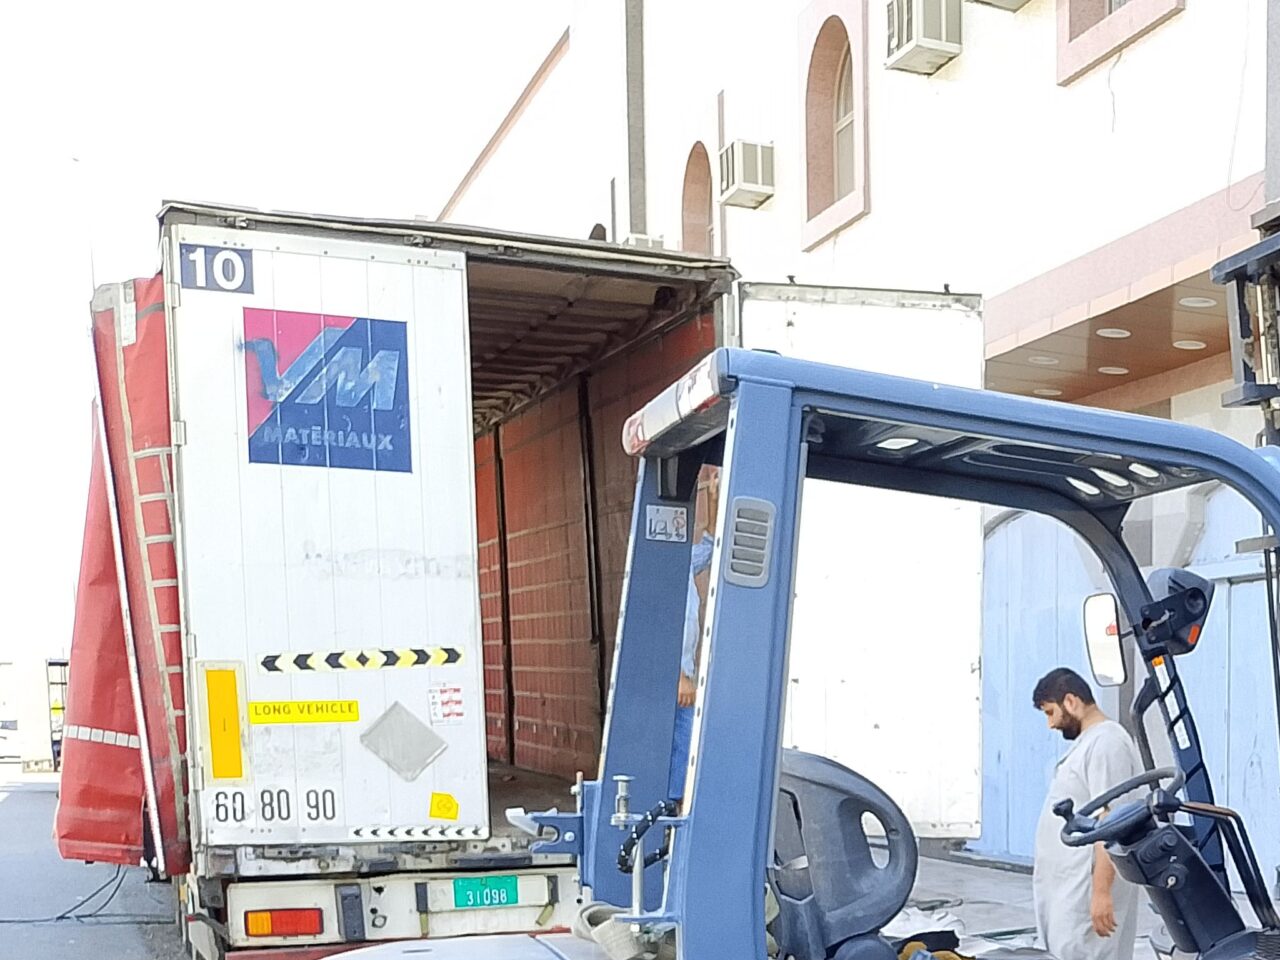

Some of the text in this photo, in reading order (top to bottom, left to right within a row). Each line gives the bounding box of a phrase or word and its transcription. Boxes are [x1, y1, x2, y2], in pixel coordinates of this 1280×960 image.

[189, 247, 246, 290] 10
[255, 702, 354, 716] LONG VEHICLE
[215, 789, 336, 822] 60 80 90
